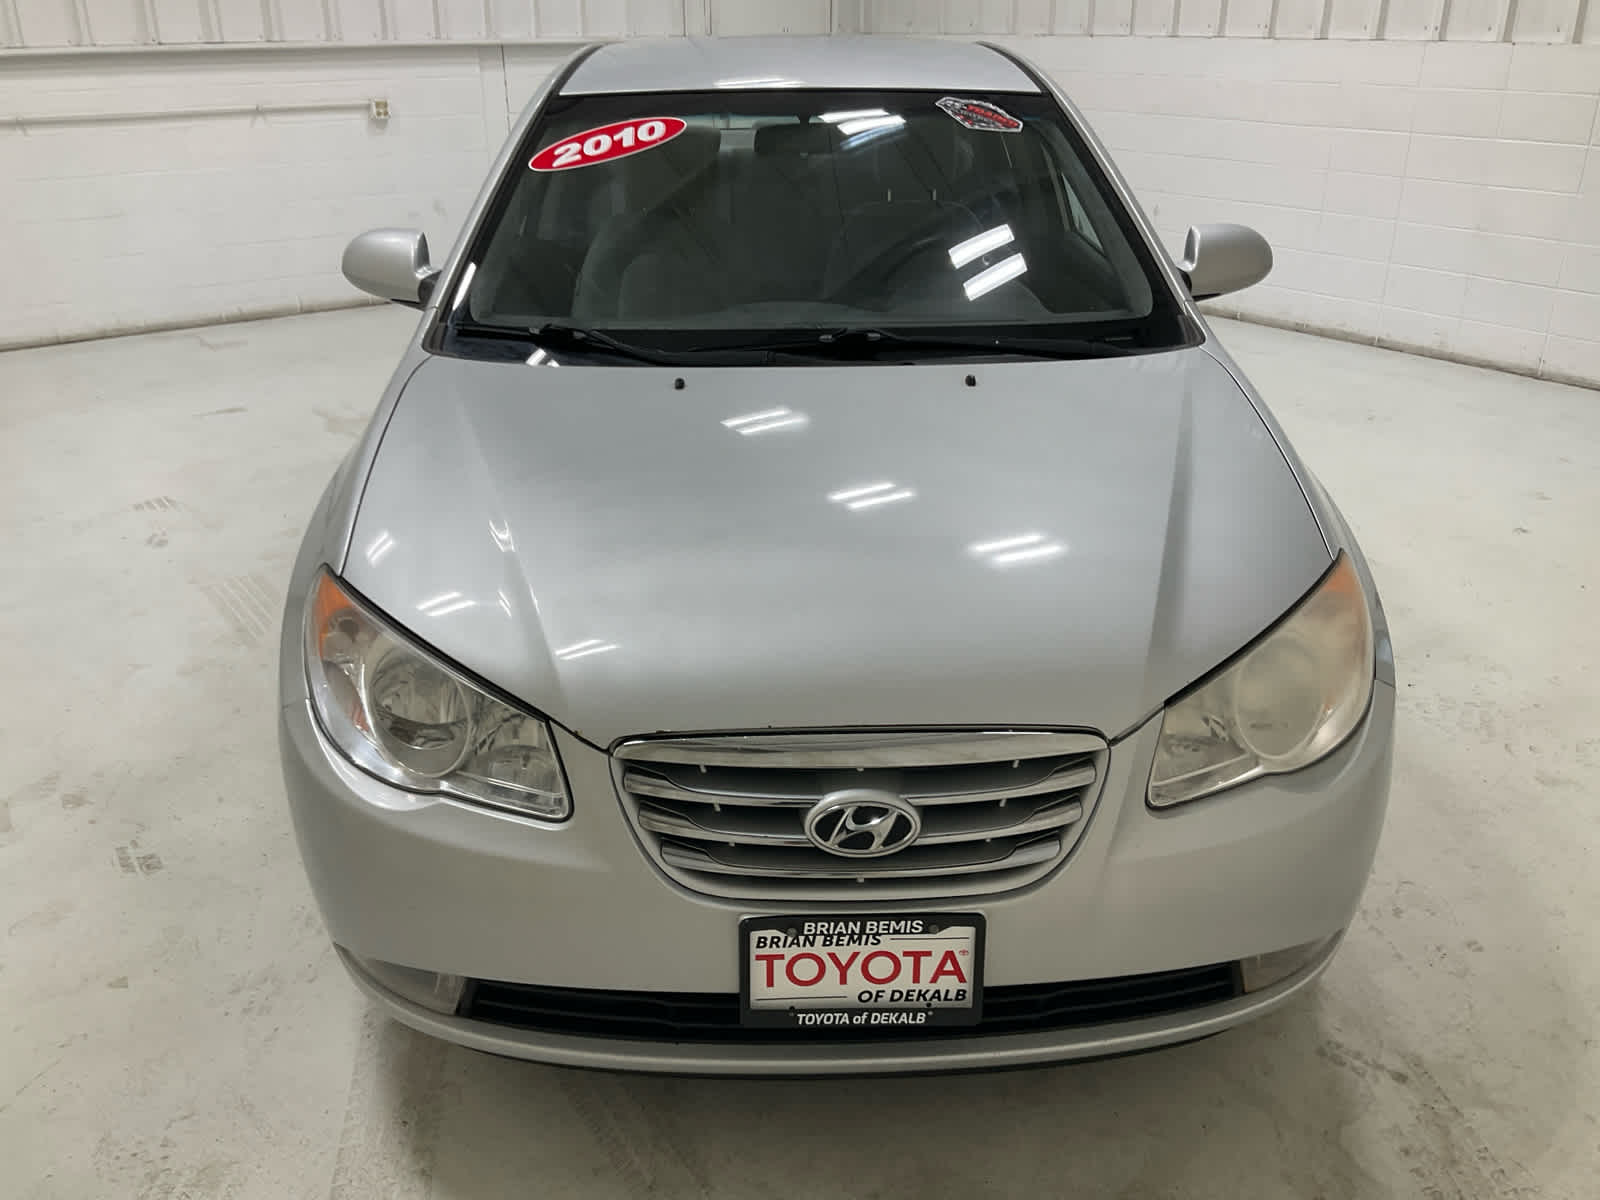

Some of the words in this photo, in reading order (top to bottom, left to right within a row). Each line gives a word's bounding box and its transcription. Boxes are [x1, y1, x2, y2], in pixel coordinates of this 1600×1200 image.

[552, 120, 667, 168] 2010
[803, 921, 861, 935] BRIAN
[865, 920, 924, 934] BEMIS
[756, 935, 816, 948] BRIAN
[821, 934, 882, 947] BEMIS
[755, 950, 968, 988] TOYOTA
[857, 990, 885, 1003] OF
[889, 989, 967, 1002] DEKALB
[797, 1013, 850, 1025] TOYOTA
[853, 1012, 868, 1024] of
[870, 1012, 926, 1024] DEKALB
